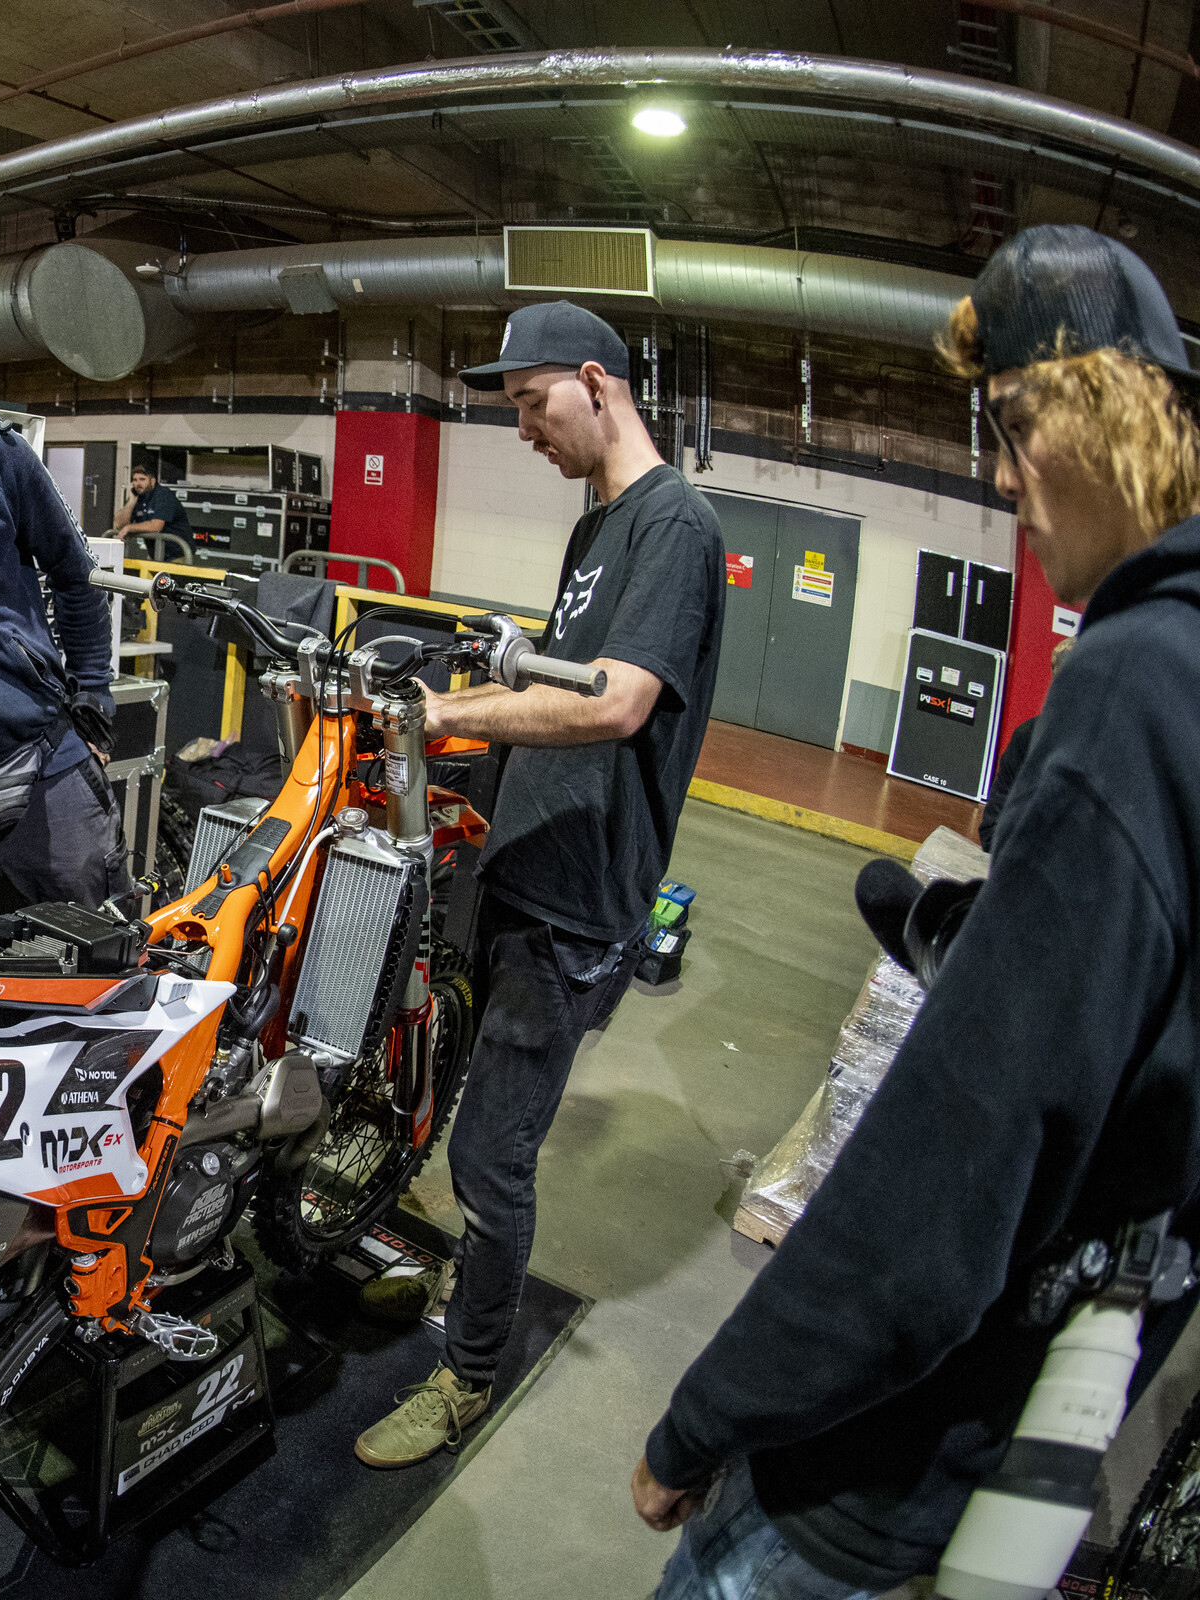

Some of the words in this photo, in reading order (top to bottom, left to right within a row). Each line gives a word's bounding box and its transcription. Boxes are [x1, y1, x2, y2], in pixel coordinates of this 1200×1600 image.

[923, 773, 940, 784] CASE
[940, 778, 947, 787] 10
[67, 1091, 100, 1104] ATHENA
[103, 1133, 124, 1147] SX
[58, 1157, 103, 1174] MOTORSPORTS
[12, 1336, 51, 1386] DUBYA
[191, 1353, 245, 1422] 22
[143, 1438, 182, 1470] CHAD
[182, 1414, 216, 1444] REED
